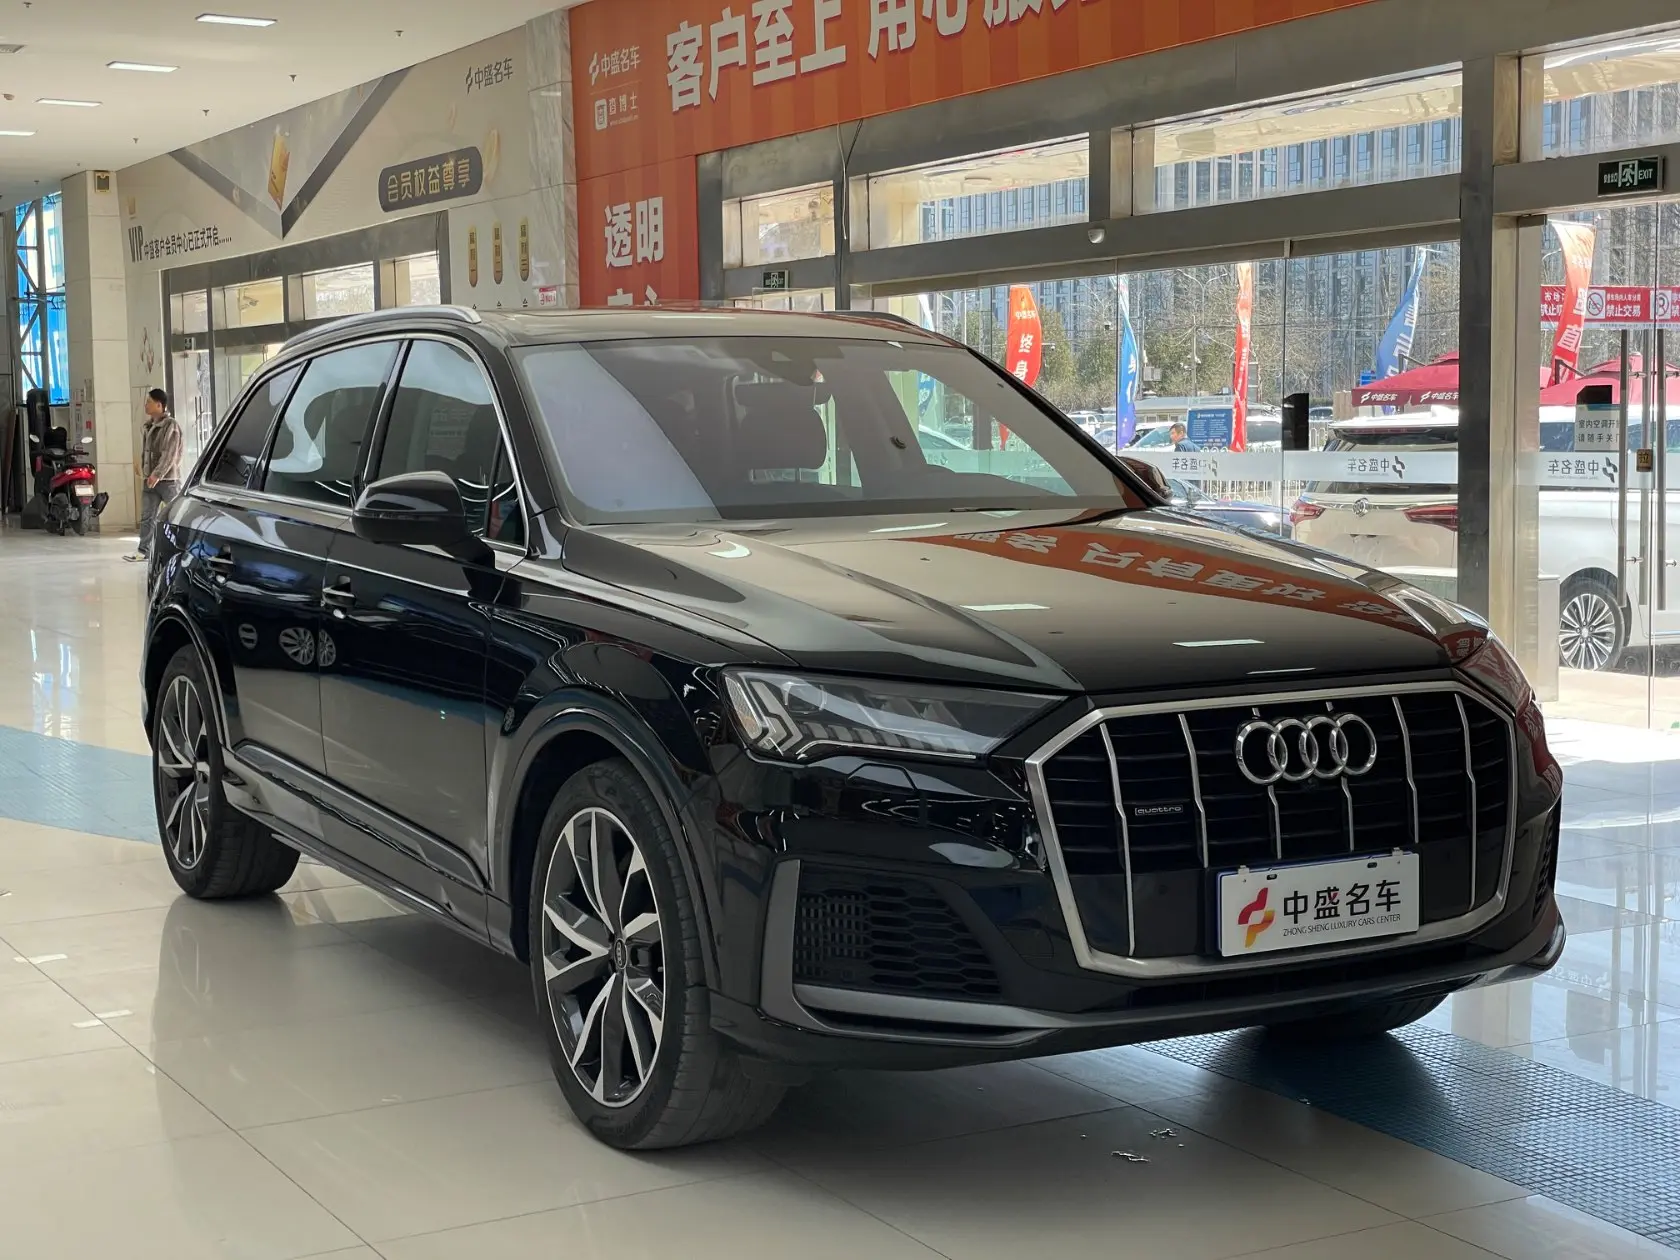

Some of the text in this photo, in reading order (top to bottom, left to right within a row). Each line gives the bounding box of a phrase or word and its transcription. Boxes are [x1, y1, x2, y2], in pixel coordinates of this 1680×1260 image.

[601, 45, 641, 78] 中盛名车
[667, 0, 846, 112] 客户至上
[474, 57, 513, 90] 中盛名车
[387, 158, 471, 203] 会员权益尊享
[1638, 169, 1653, 180] EXIT
[128, 226, 144, 263] VIP
[605, 197, 664, 268] 透明
[1371, 393, 1398, 402] 中盛名车
[1137, 806, 1182, 814] quattro
[1283, 879, 1401, 924] 中盛名车
[1283, 913, 1401, 937] ZHONG SHENG LUXURY CARS CENTER
